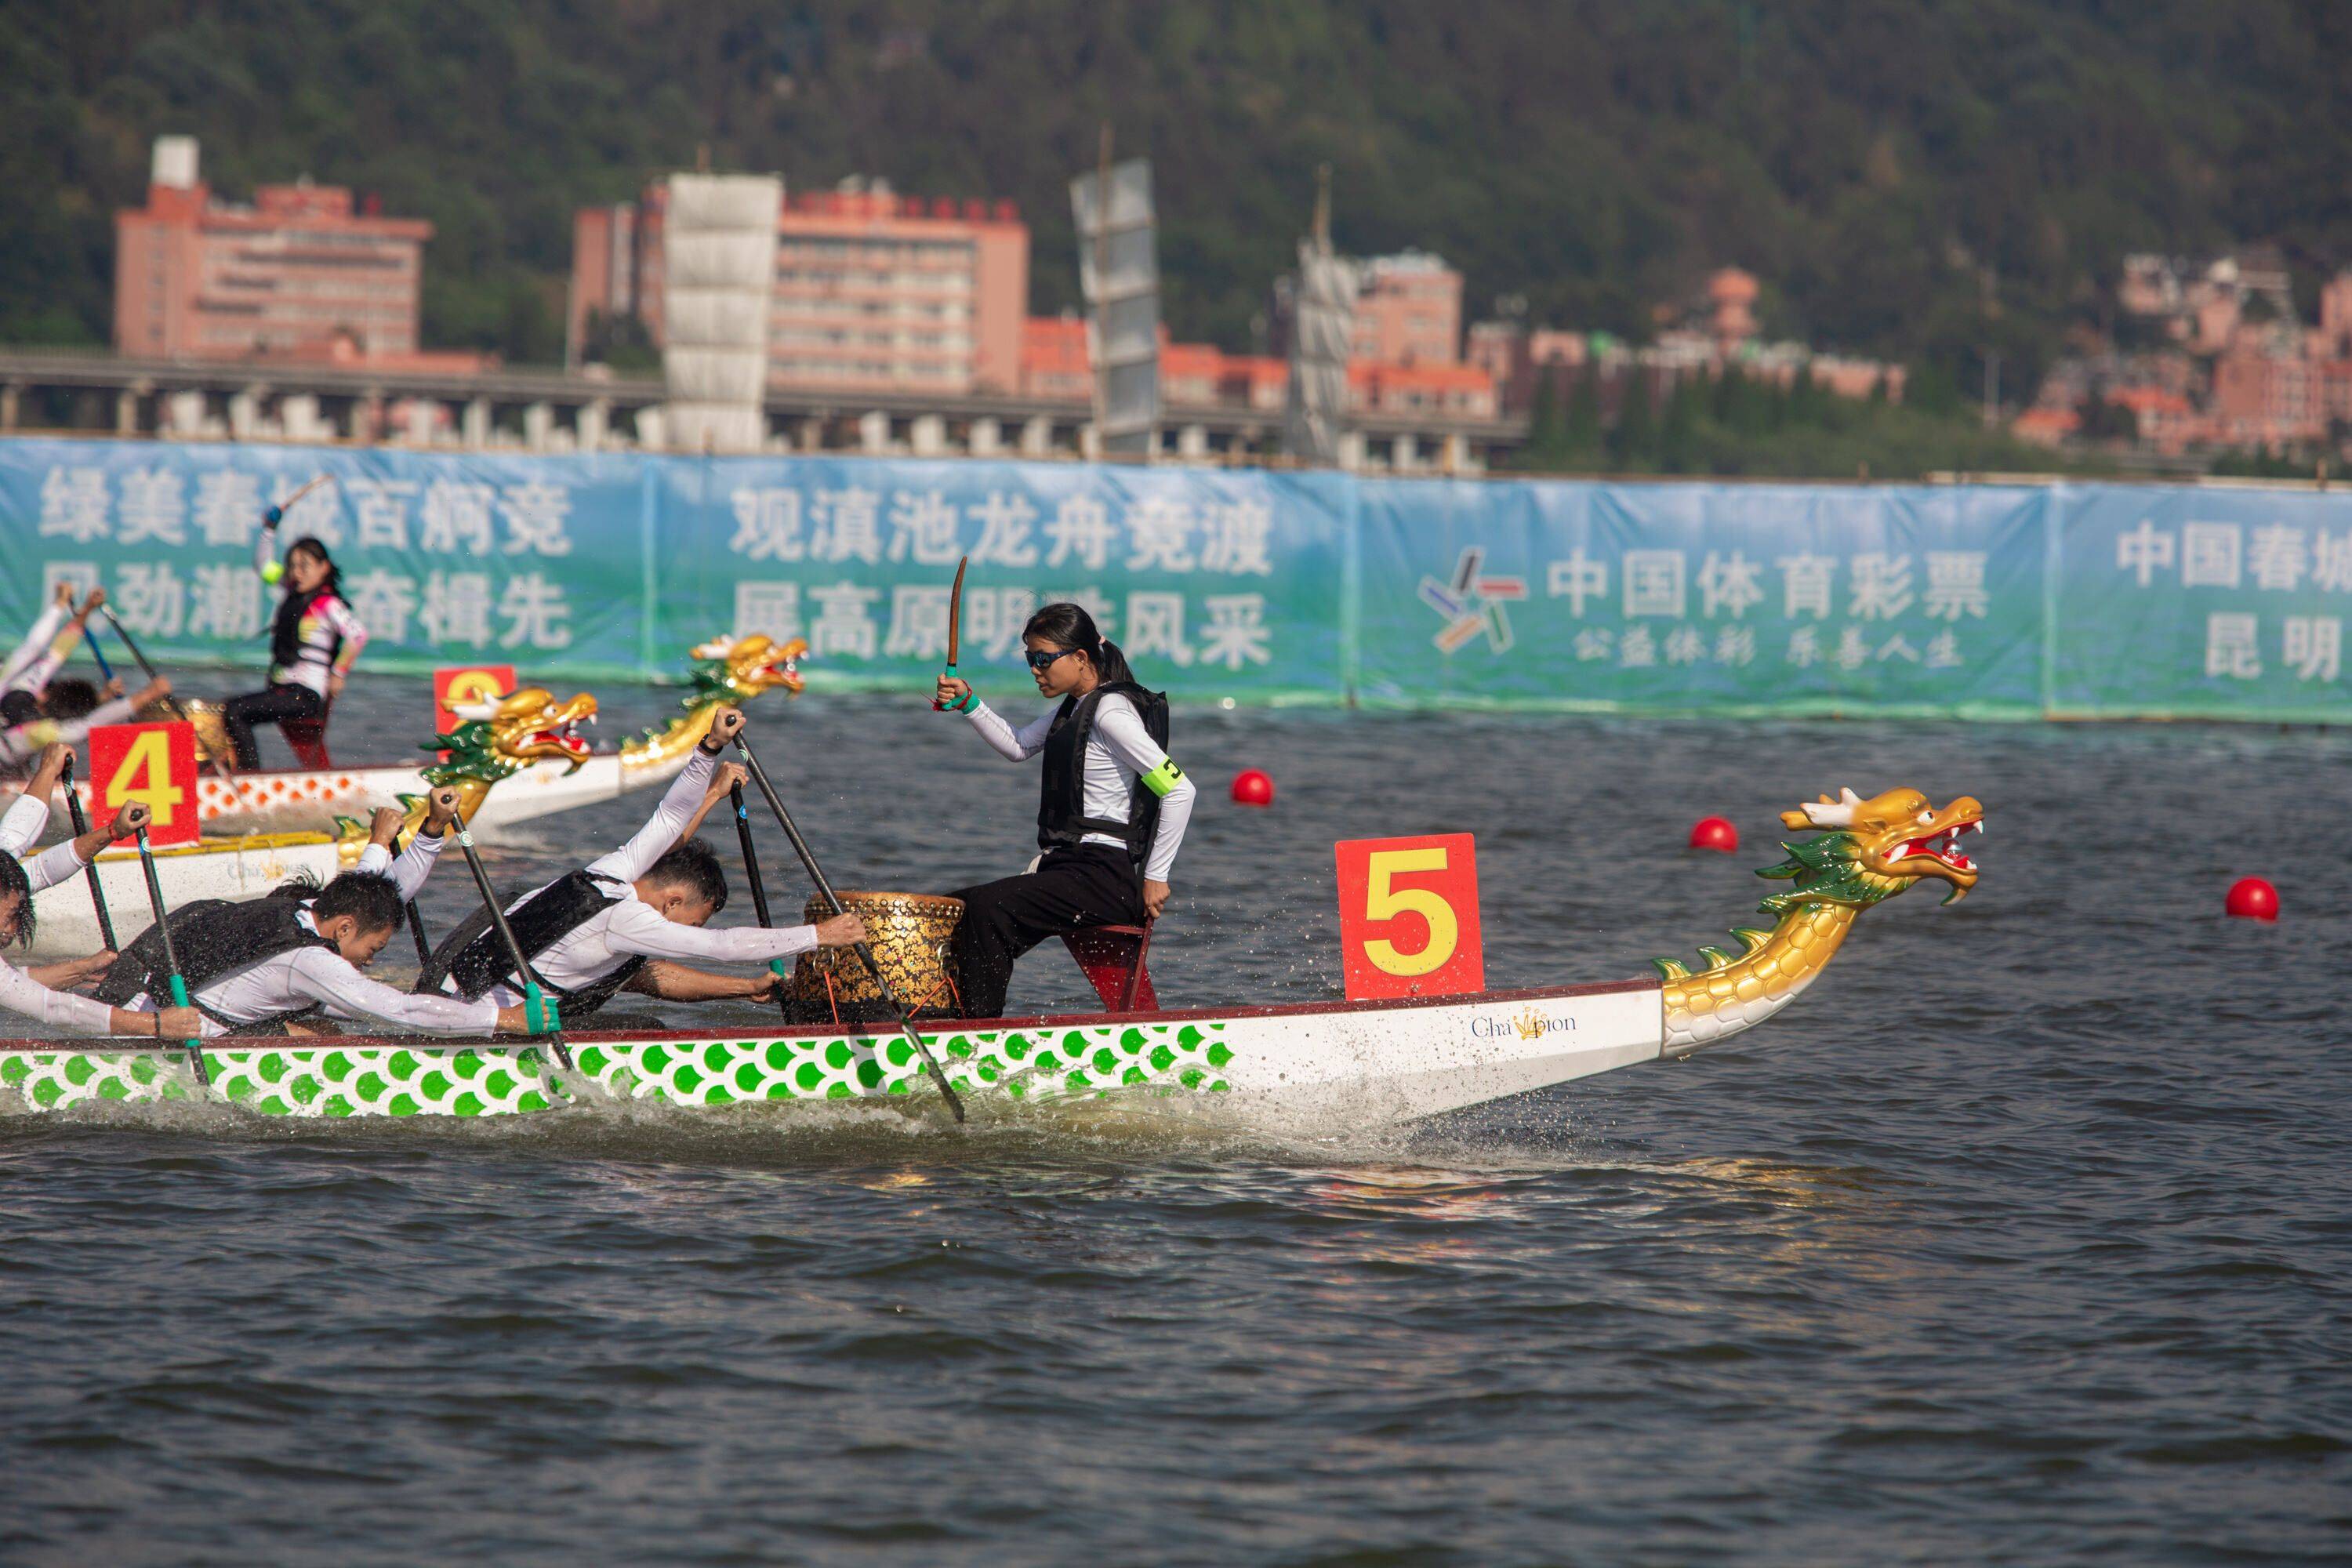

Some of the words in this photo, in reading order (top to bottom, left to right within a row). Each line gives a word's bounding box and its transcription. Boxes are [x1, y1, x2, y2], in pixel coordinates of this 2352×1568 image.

[729, 485, 1274, 578] 观滇池龙舟竞渡
[42, 559, 573, 650] 风劲潮奋楫先
[732, 580, 1273, 672] 展高原明风采
[1547, 546, 1991, 622] 中国体育彩票
[2205, 612, 2343, 681] 昆明
[106, 731, 184, 827] 4
[1363, 848, 1458, 977] 5
